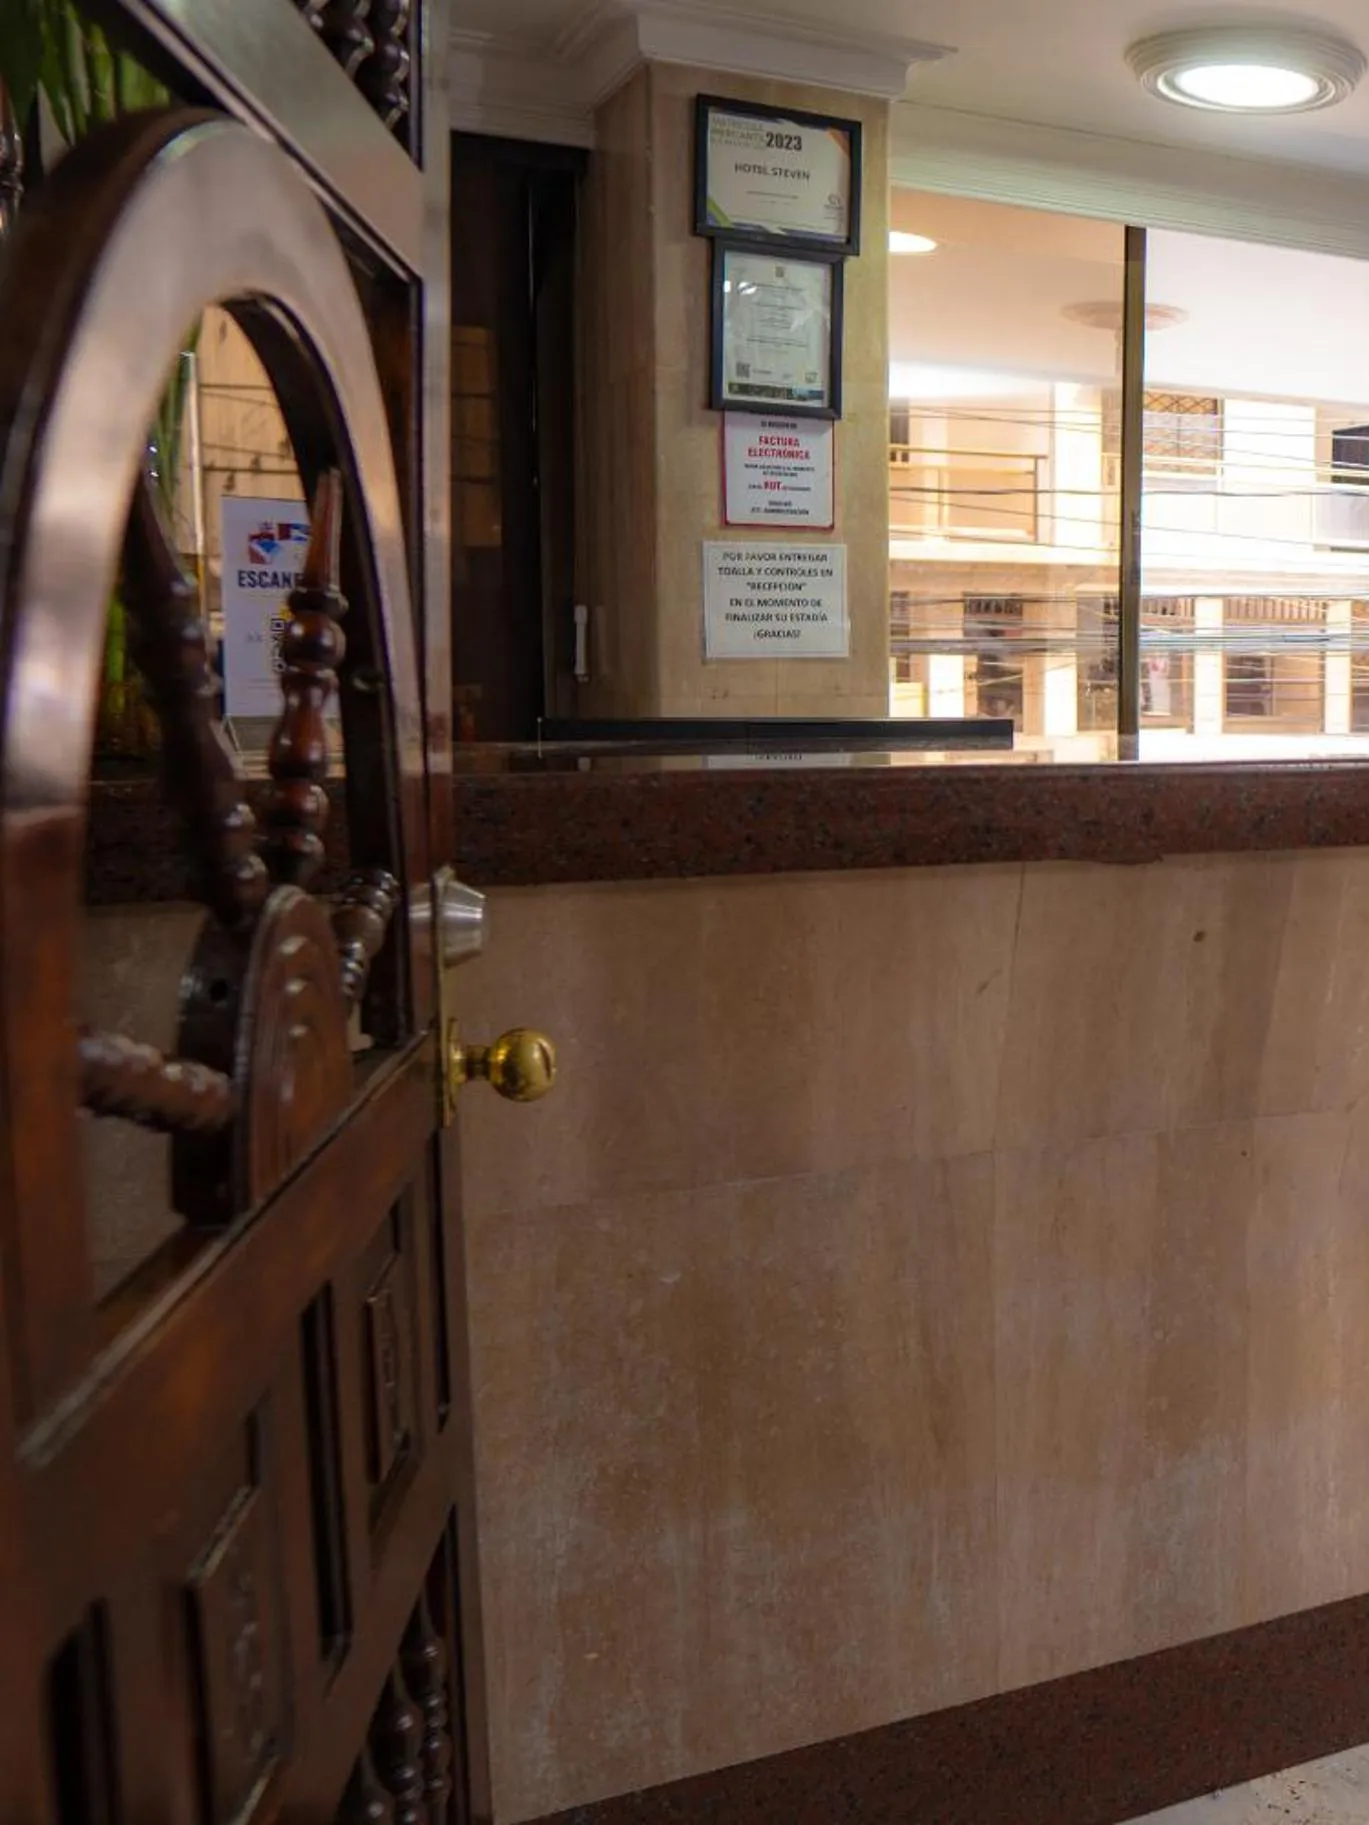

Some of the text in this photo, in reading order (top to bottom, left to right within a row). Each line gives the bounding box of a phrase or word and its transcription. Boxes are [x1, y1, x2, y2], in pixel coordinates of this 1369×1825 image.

[766, 132, 802, 151] 2023
[771, 167, 810, 180] STEVEN
[759, 436, 800, 447] FACTURA
[723, 552, 742, 562] POR
[745, 552, 777, 561] FAVOR
[756, 567, 762, 576] Y
[764, 567, 818, 577] CONTROLES
[820, 568, 833, 577] EN
[729, 598, 823, 608] EN EL MOMENTO DE
[725, 613, 773, 622] FINALIZAR
[775, 613, 787, 622] SU
